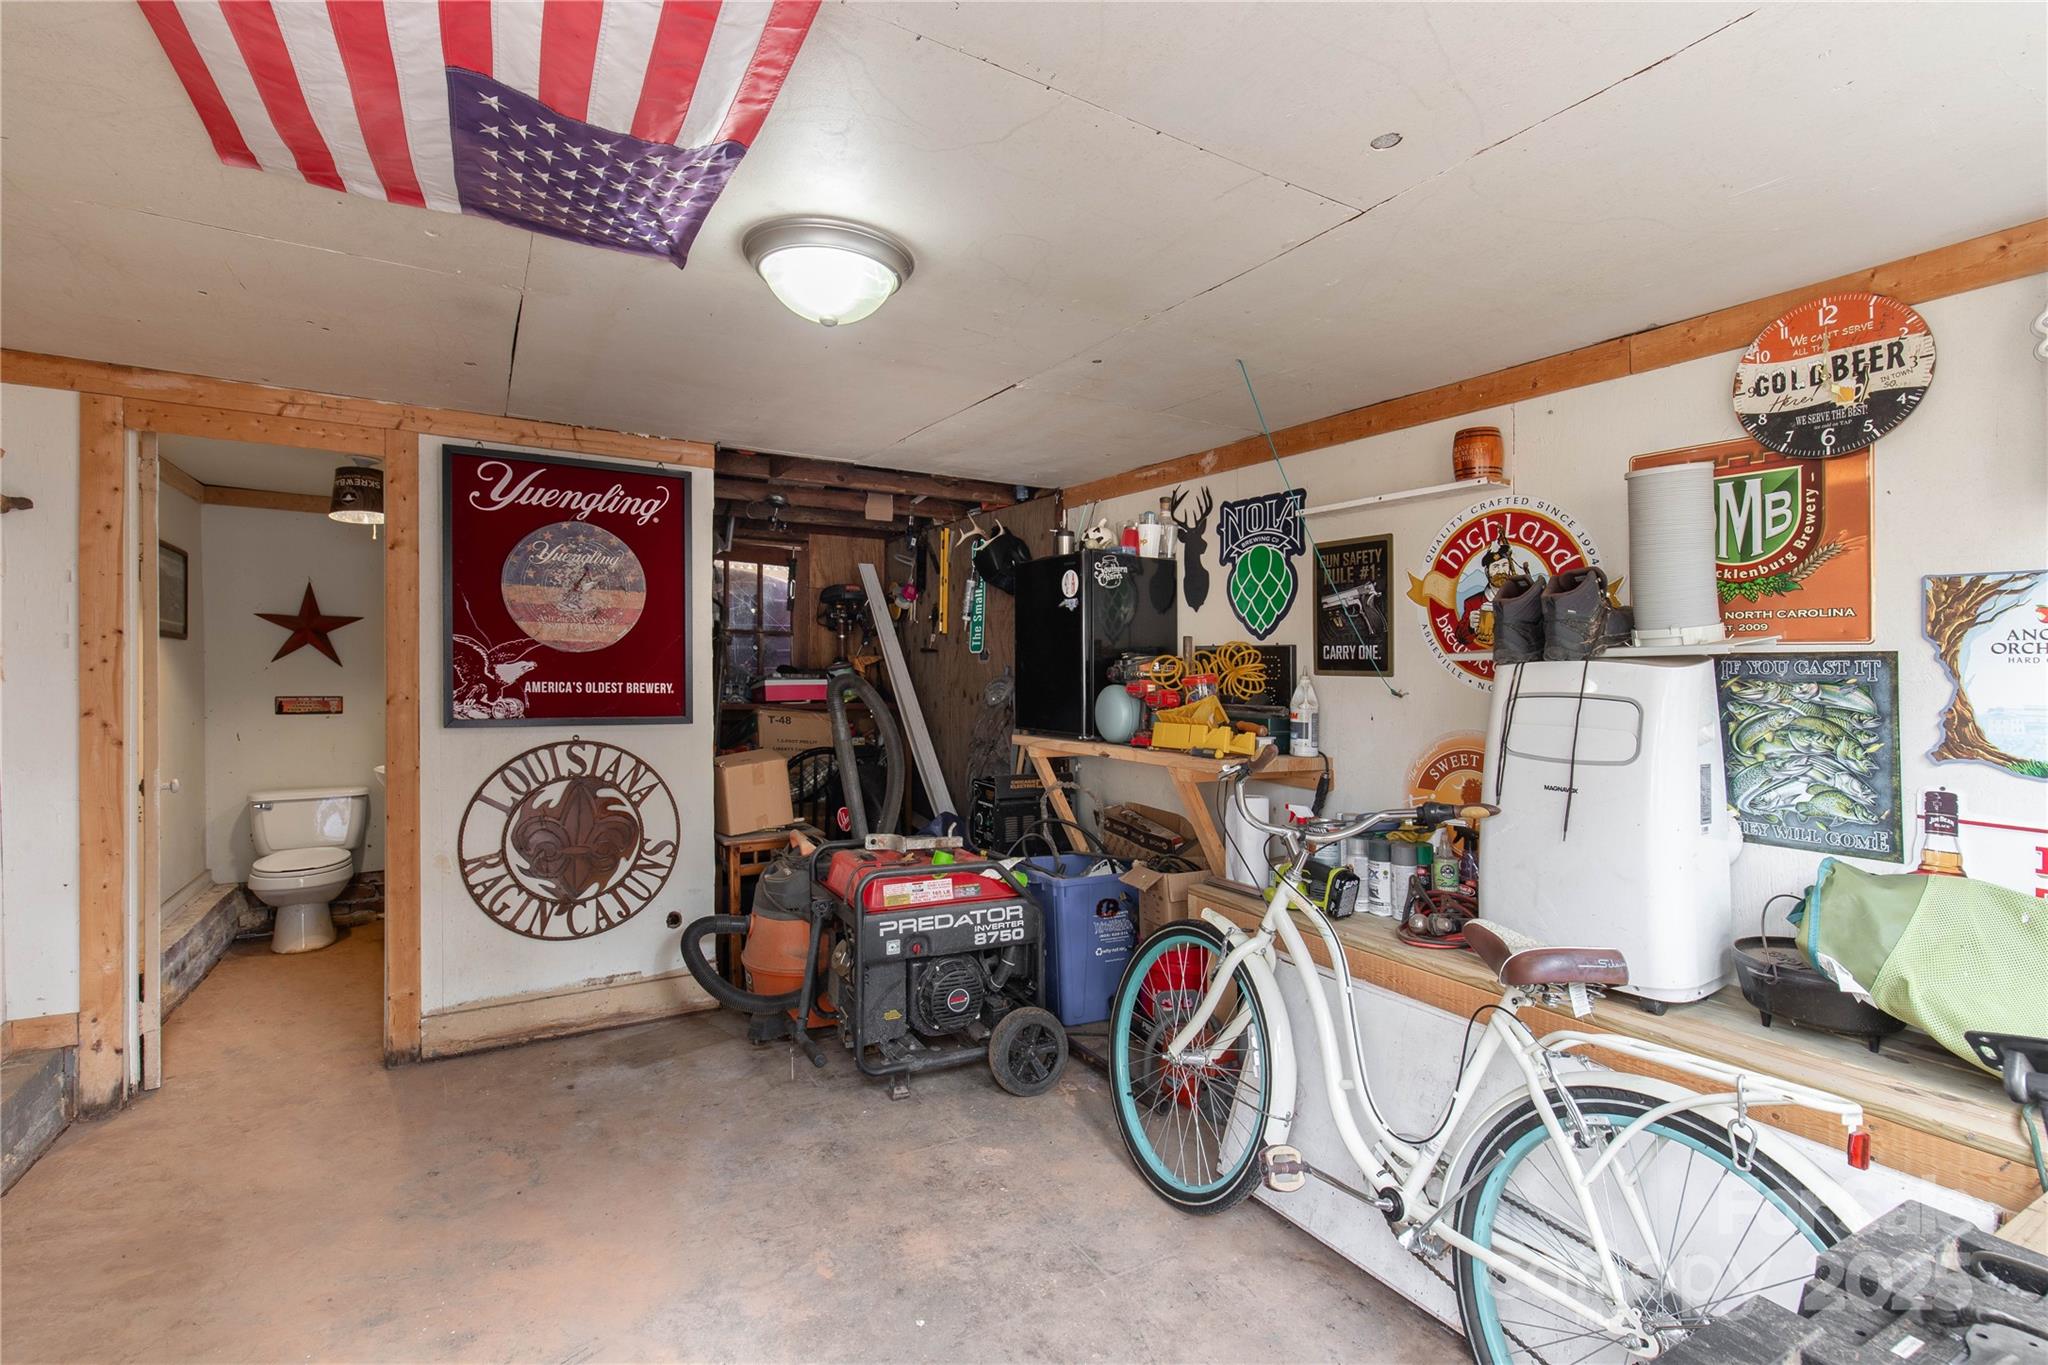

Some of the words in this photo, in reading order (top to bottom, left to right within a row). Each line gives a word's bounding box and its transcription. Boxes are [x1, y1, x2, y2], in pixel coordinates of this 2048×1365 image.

[1818, 305, 1838, 326] 12
[1780, 327, 1789, 340] 11
[1898, 327, 1909, 340] 2
[1756, 351, 1770, 363] 10
[1831, 342, 1906, 381] BEER
[1909, 356, 1918, 368] 3
[1896, 392, 1907, 403] 4
[1758, 414, 1767, 425] 8
[1796, 416, 1806, 426] WE
[1808, 412, 1830, 423] SERVE
[1832, 409, 1846, 420] THE
[1847, 405, 1868, 417] BEST!
[1863, 420, 1874, 432] 5
[1785, 431, 1794, 442] 7
[1821, 428, 1836, 446] 6
[469, 461, 670, 526] Yuengling
[1221, 495, 1301, 560] NOLA
[1714, 478, 1793, 558] MB
[1425, 514, 1465, 563] QUALITY
[1470, 496, 1530, 514] CRAFTED
[1536, 501, 1575, 528] SINCE
[1577, 531, 1600, 566] 1994
[1716, 551, 1797, 580] cklenburg
[1793, 488, 1819, 550] Brewery
[1241, 536, 1270, 548] BREWING
[529, 540, 625, 566] Yuengling
[1320, 554, 1340, 569] GUN
[1343, 549, 1382, 567] SAFETY
[1324, 566, 1354, 585] RULE
[1360, 565, 1381, 581] #1:
[1725, 611, 1772, 620] NORTH
[1776, 608, 1856, 619] CAROLINA
[972, 626, 982, 647] The
[1738, 623, 1769, 632] 2009
[1323, 645, 1356, 660] CARRY
[1358, 645, 1381, 660] ONE.
[1421, 623, 1464, 680] ASHEVILLE
[1720, 660, 1740, 680] IF
[1744, 660, 1789, 677] YOU
[1794, 660, 1850, 675] CAST
[1855, 660, 1881, 682] IT
[524, 681, 583, 694] AMERICA'S
[585, 682, 623, 694] OLDEST
[626, 682, 674, 694] BREWERY.
[768, 715, 792, 725] T-48
[1429, 753, 1480, 781] SWEET
[478, 743, 661, 817] LOUISIANA
[1773, 825, 1821, 843] WILL
[1825, 831, 1890, 853] COME
[566, 838, 678, 936] CAJUNS
[880, 905, 1023, 936] PREDATOR
[974, 920, 1024, 932] INVERTER
[974, 929, 1024, 945] 8750
